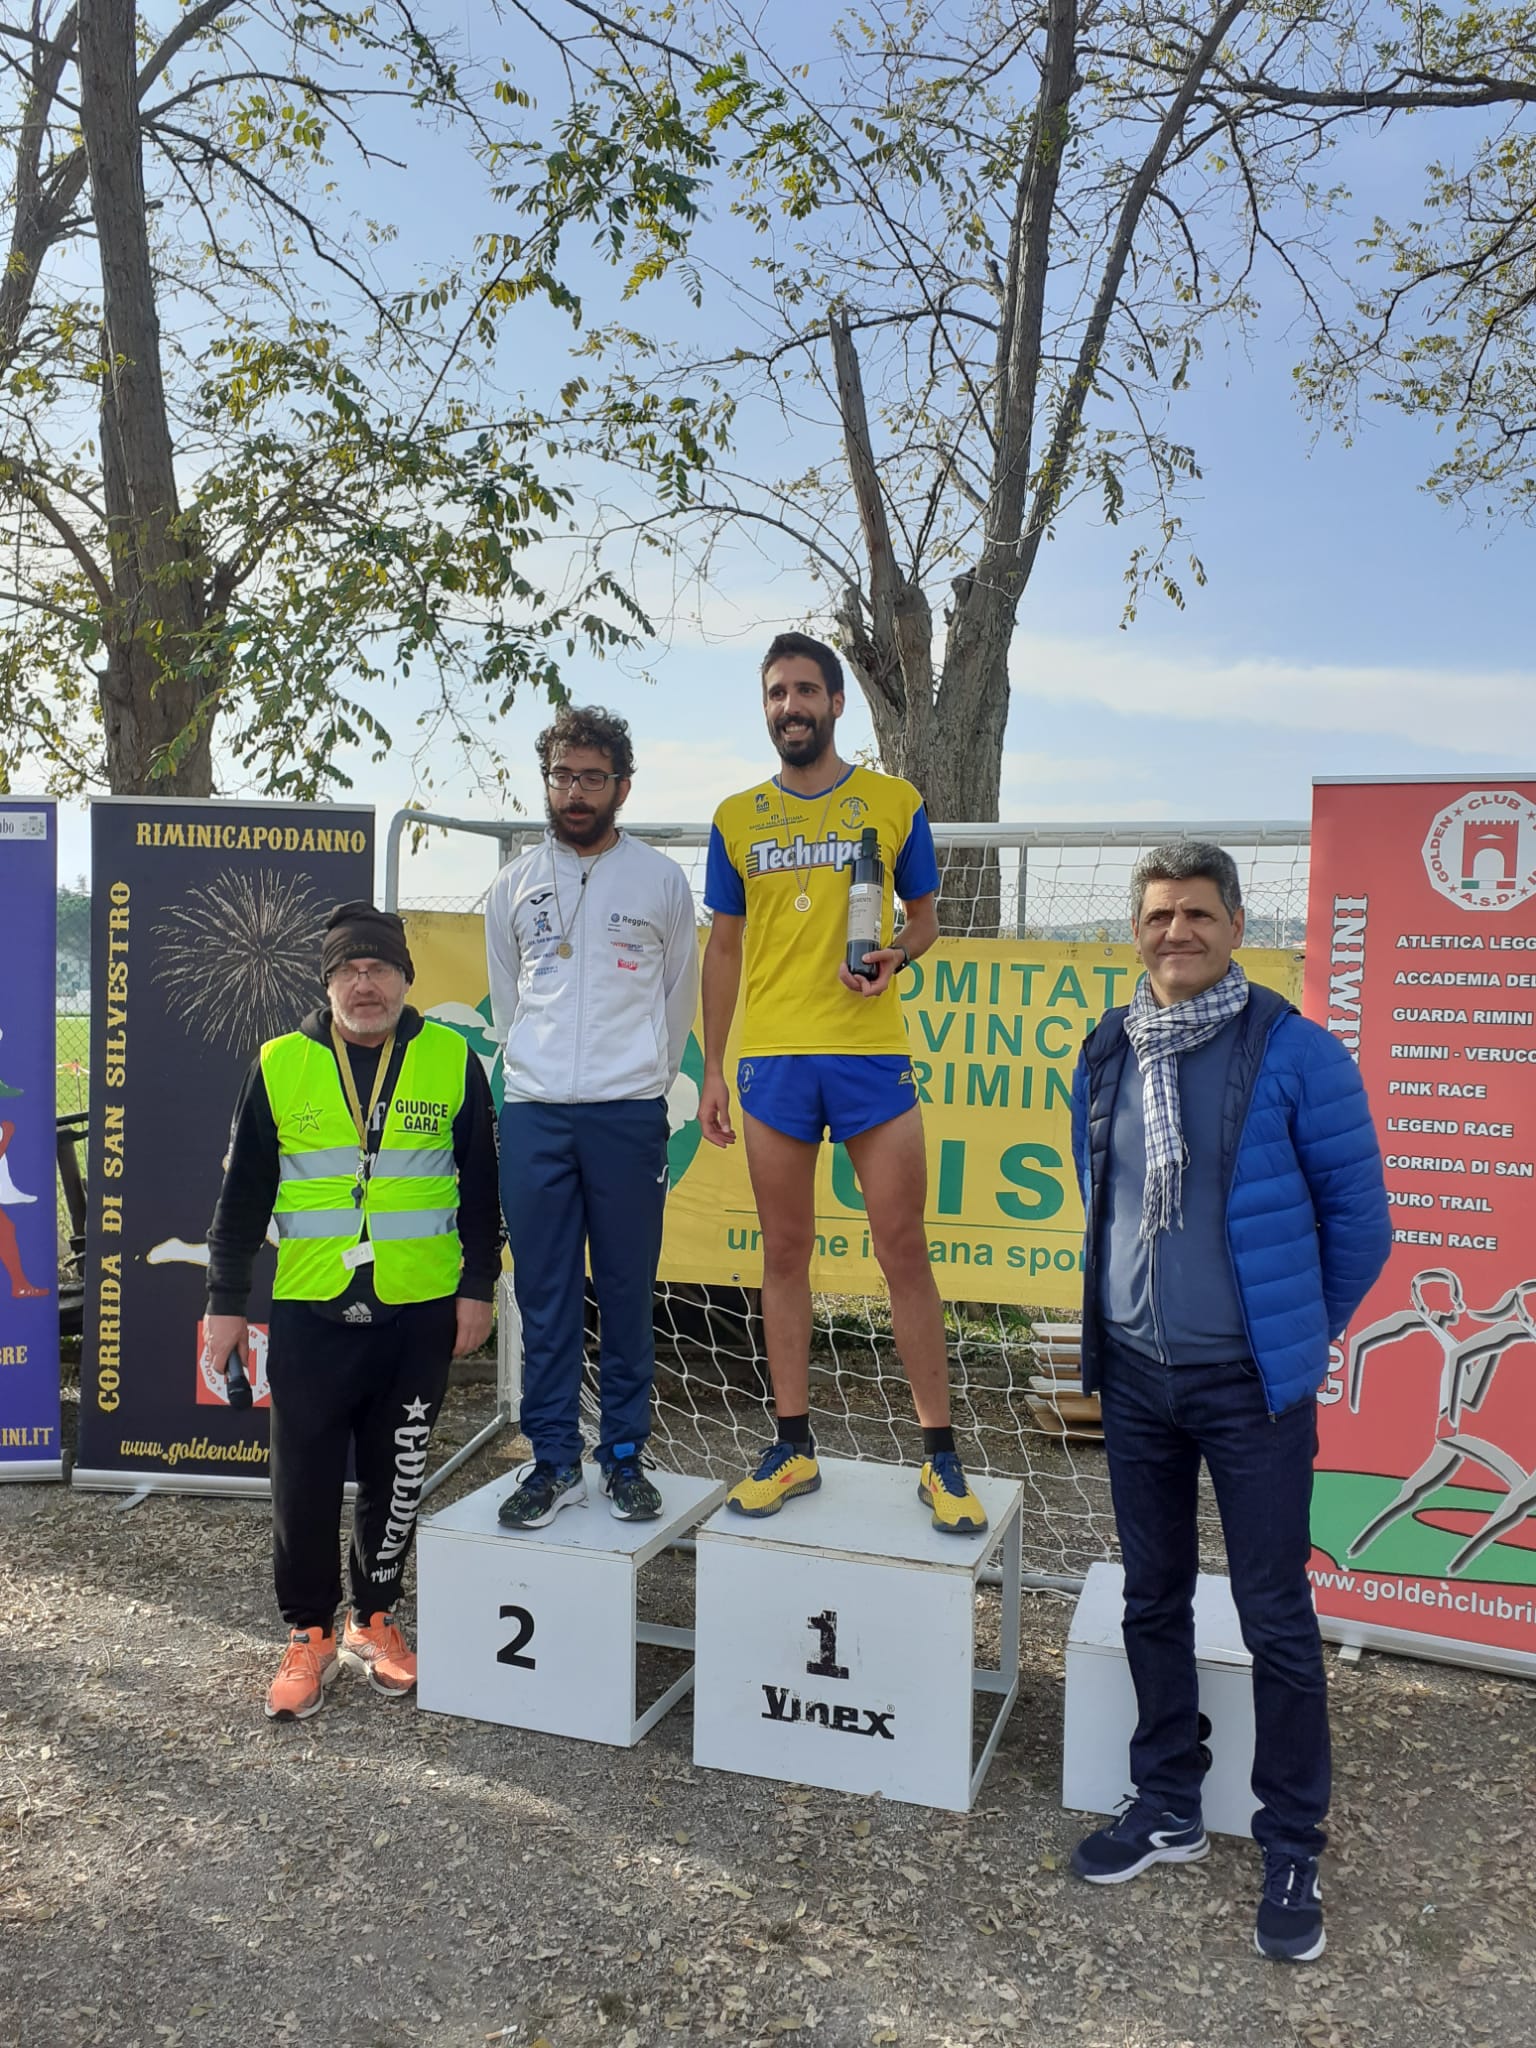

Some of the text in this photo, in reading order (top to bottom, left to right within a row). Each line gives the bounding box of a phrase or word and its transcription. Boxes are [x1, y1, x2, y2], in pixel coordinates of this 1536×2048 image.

[1467, 794, 1521, 811] CLUB
[136, 822, 366, 854] RIMINICAPODANNO
[1430, 815, 1453, 883] GOLDEN
[1459, 891, 1516, 907] A.S.D.
[1395, 935, 1485, 950] ATLETICA
[1394, 971, 1501, 987] ACCADEMIA
[1392, 1008, 1533, 1025] GUARDA RIMINI
[1391, 1045, 1449, 1060] RIMINI
[1388, 1081, 1487, 1099] PINK RACE
[395, 1098, 449, 1118] GIUDICE
[404, 1115, 439, 1132] GARA
[1386, 1118, 1514, 1138] LEGEND RACE
[98, 881, 131, 1412] CORRIDA DI SAN SILVESTRO
[1385, 1155, 1533, 1177] CORRIDA DI SAN
[1439, 1195, 1493, 1212] TRAIL
[1448, 1234, 1498, 1250] RACE
[0, 1427, 54, 1447] INI.IT
[376, 1425, 430, 1561] GOLDEN
[496, 1604, 537, 1671] 2
[806, 1609, 850, 1680] 1
